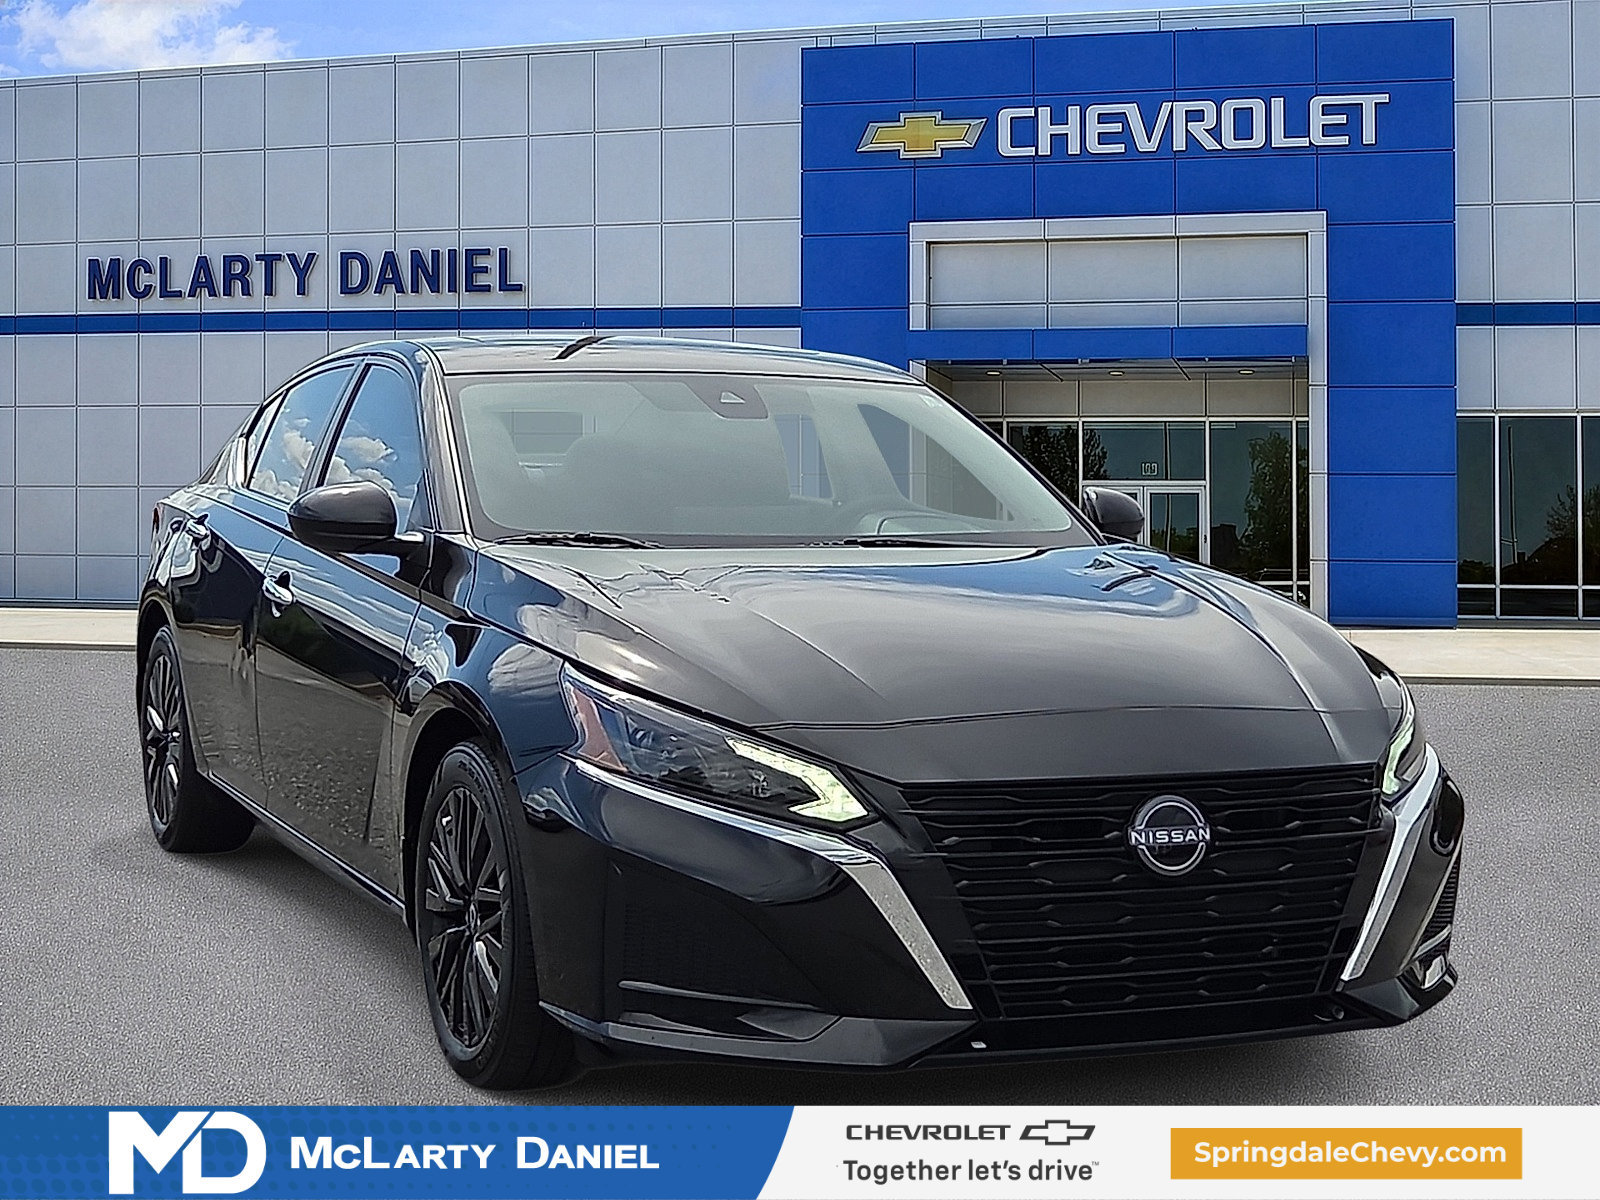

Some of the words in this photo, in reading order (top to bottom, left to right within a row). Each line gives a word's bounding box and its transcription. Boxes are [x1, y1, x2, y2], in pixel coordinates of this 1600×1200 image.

[997, 94, 1390, 157] CHEVROLET
[340, 246, 525, 295] DANIEL
[1131, 828, 1211, 844] NISSAN
